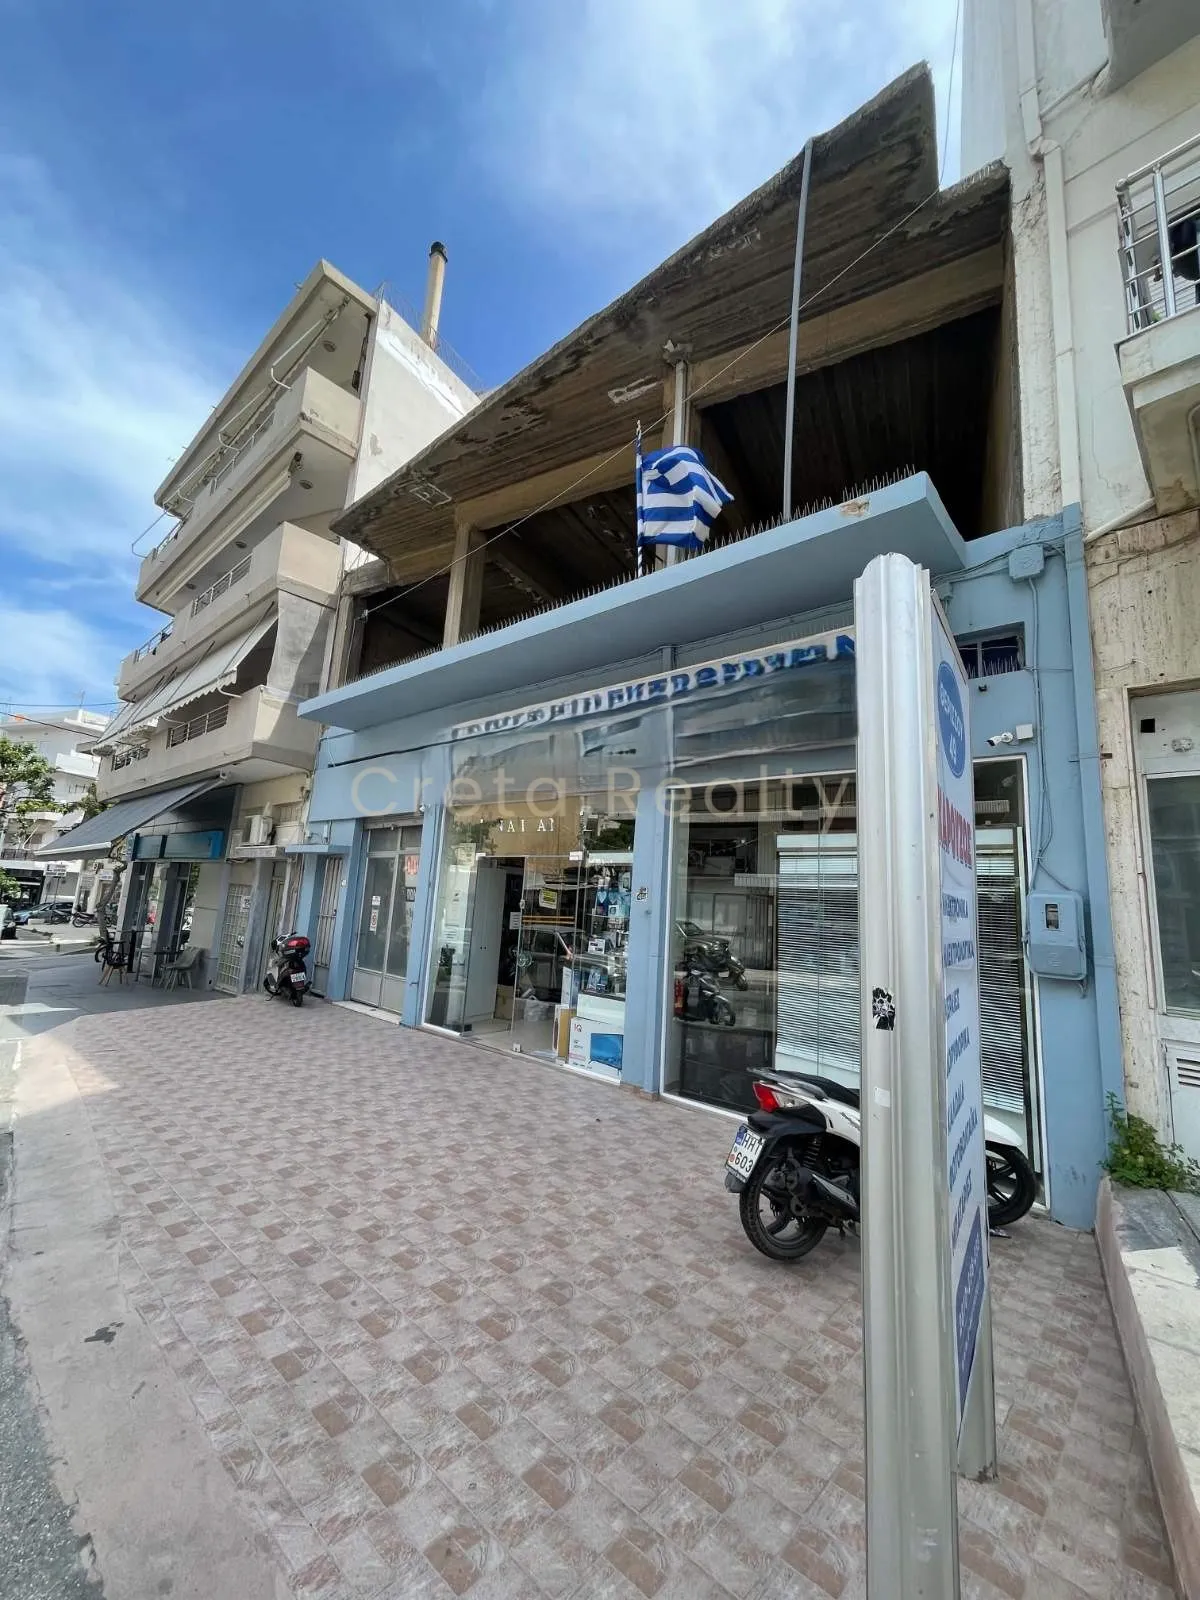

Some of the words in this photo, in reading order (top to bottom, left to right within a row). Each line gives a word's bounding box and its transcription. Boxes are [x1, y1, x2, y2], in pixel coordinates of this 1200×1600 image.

[942, 892, 968, 919] ΛΕΚΤΡΟΝΙΚΑ
[943, 941, 975, 968] ΛΕΚΤΡΟΛΟΓΙΚΑ
[735, 1152, 754, 1173] 603
